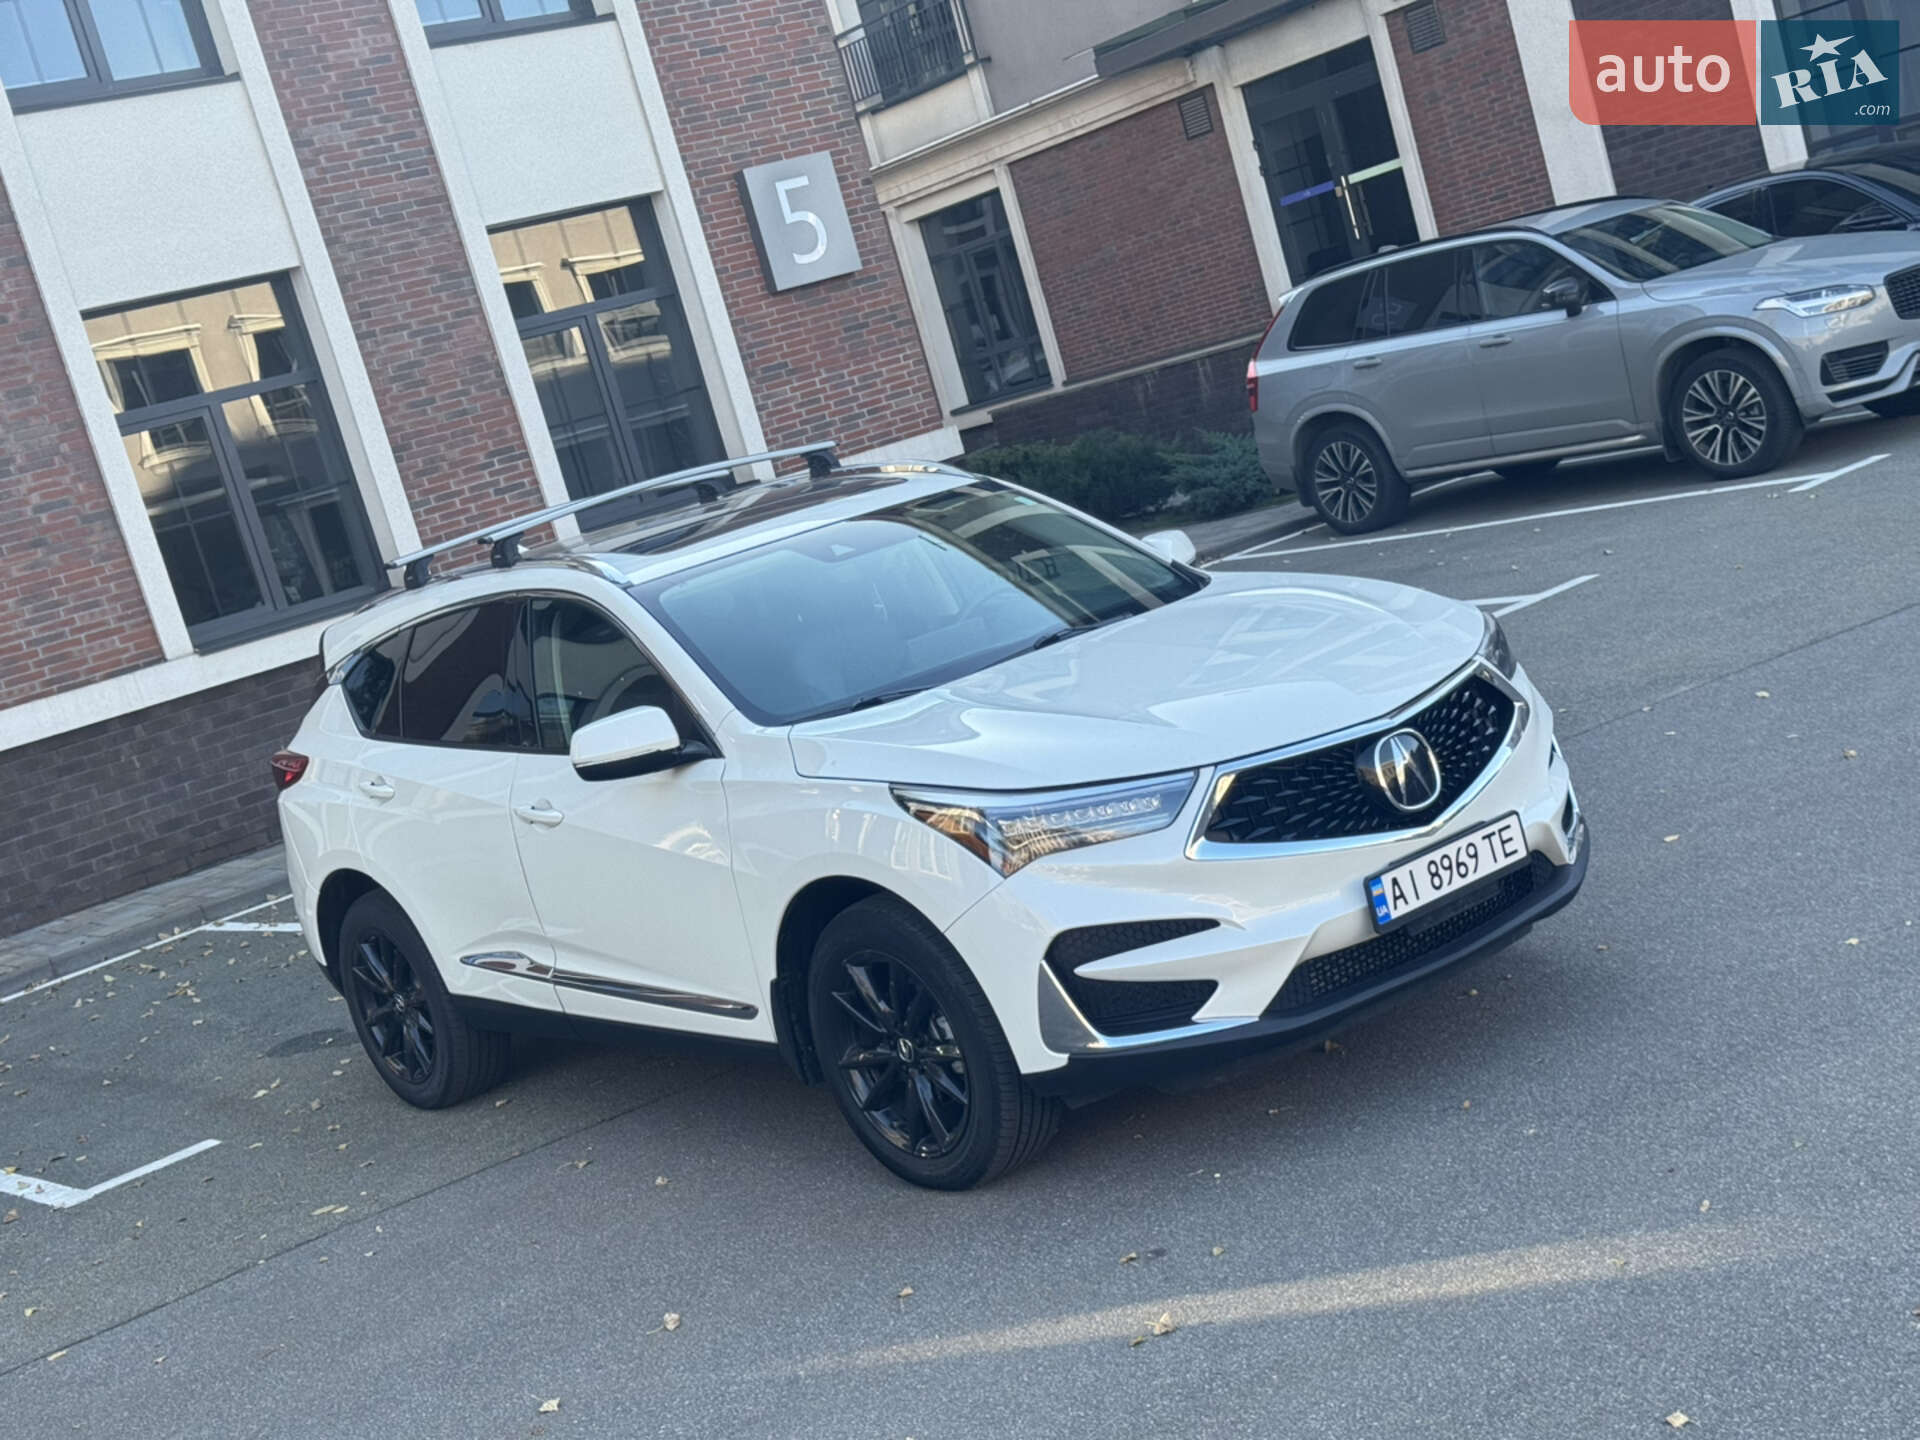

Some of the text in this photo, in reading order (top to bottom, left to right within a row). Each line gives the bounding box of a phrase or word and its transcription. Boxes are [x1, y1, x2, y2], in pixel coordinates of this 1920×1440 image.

[775, 175, 828, 265] 5
[1376, 905, 1389, 917] UA
[1391, 824, 1519, 911] AI 8969 TE
